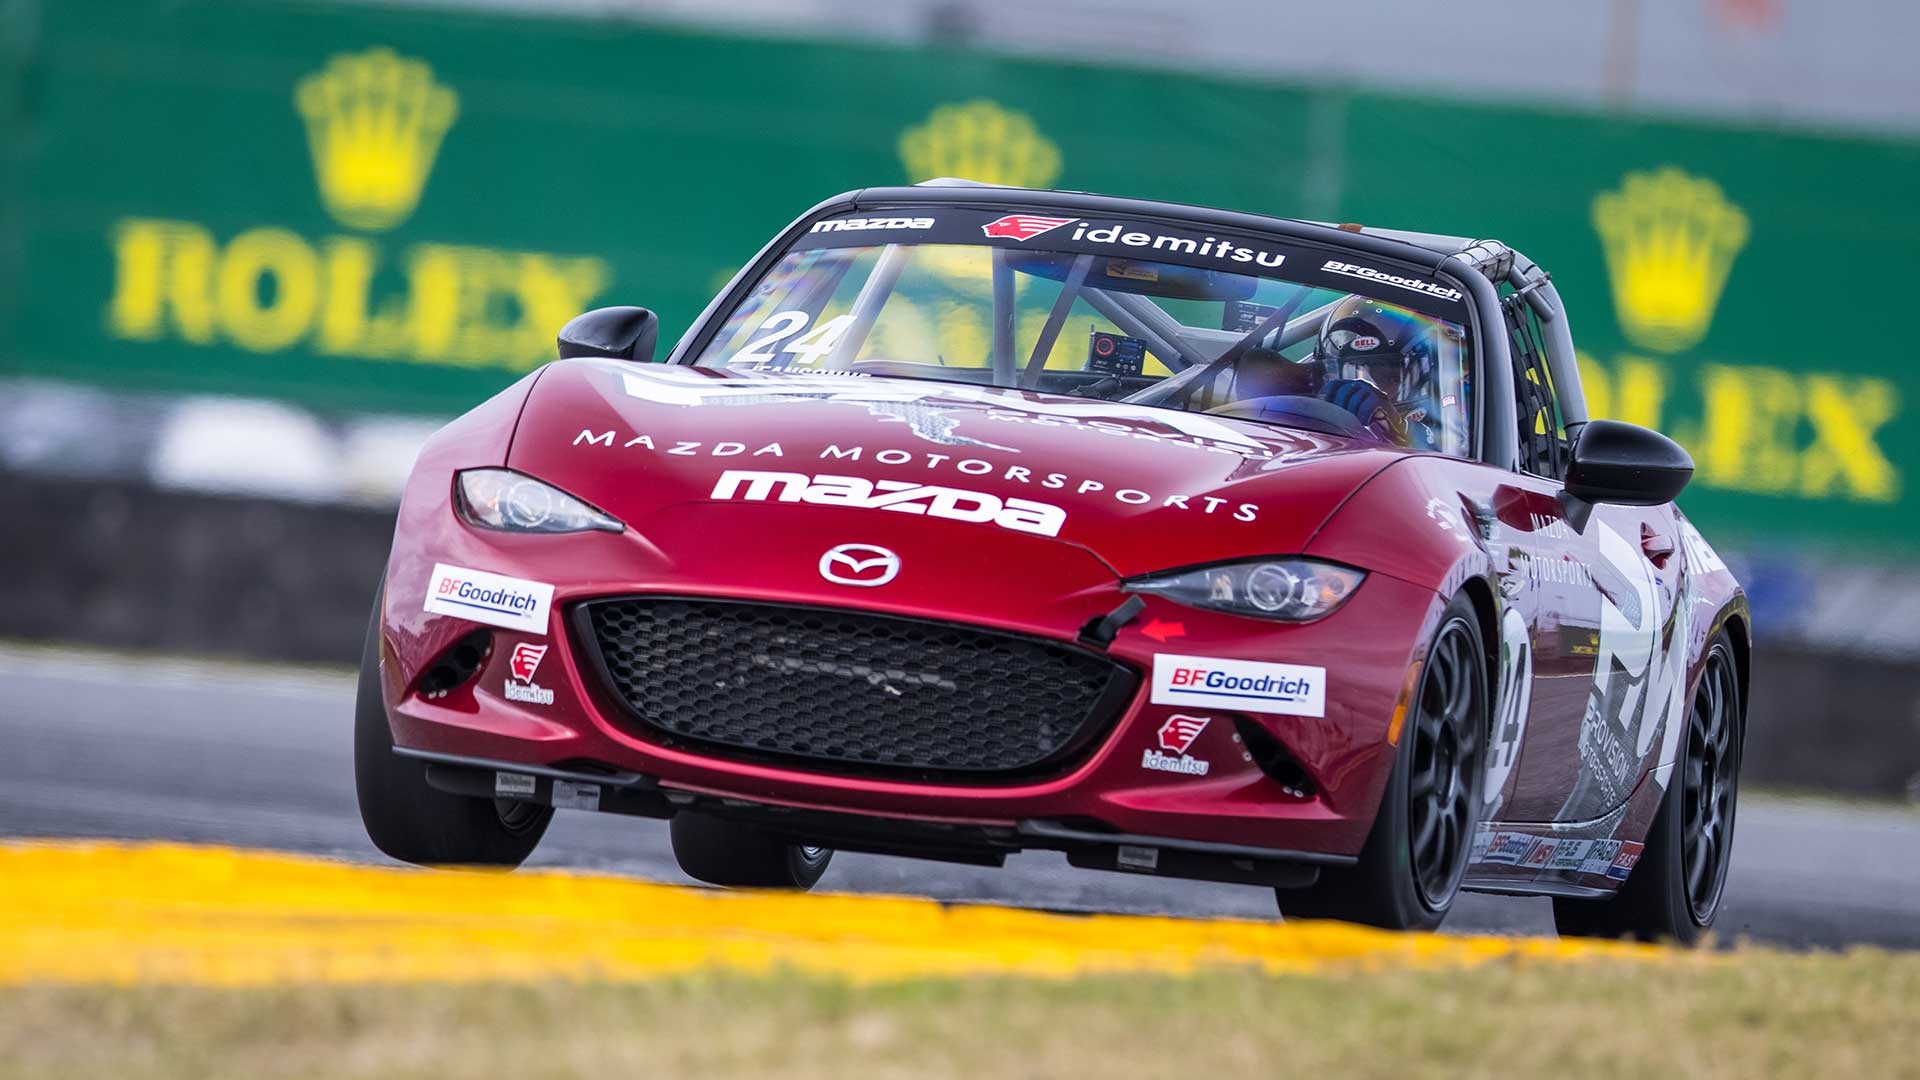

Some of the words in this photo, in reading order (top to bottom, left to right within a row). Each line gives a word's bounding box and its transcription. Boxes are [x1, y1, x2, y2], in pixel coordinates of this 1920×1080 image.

[810, 217, 935, 233] mazda
[1071, 222, 1286, 269] idemitsu
[108, 216, 612, 373] ROLEX
[1322, 260, 1463, 300] BFGoodrich
[728, 310, 858, 365] 24
[1354, 339, 1376, 347] BELL
[572, 429, 785, 457] MAZDA
[820, 444, 1259, 522] MOTORSPORTS
[710, 470, 1067, 537] mazda
[1529, 512, 1570, 540] MAZDA
[1520, 553, 1593, 588] MOTORSPORTS
[437, 577, 537, 612] BFGoodrich
[504, 679, 554, 704] idemitsu
[1171, 667, 1310, 696] BFGoodrich
[1141, 748, 1209, 775] idemitsu
[1586, 703, 1630, 786] PROVISION
